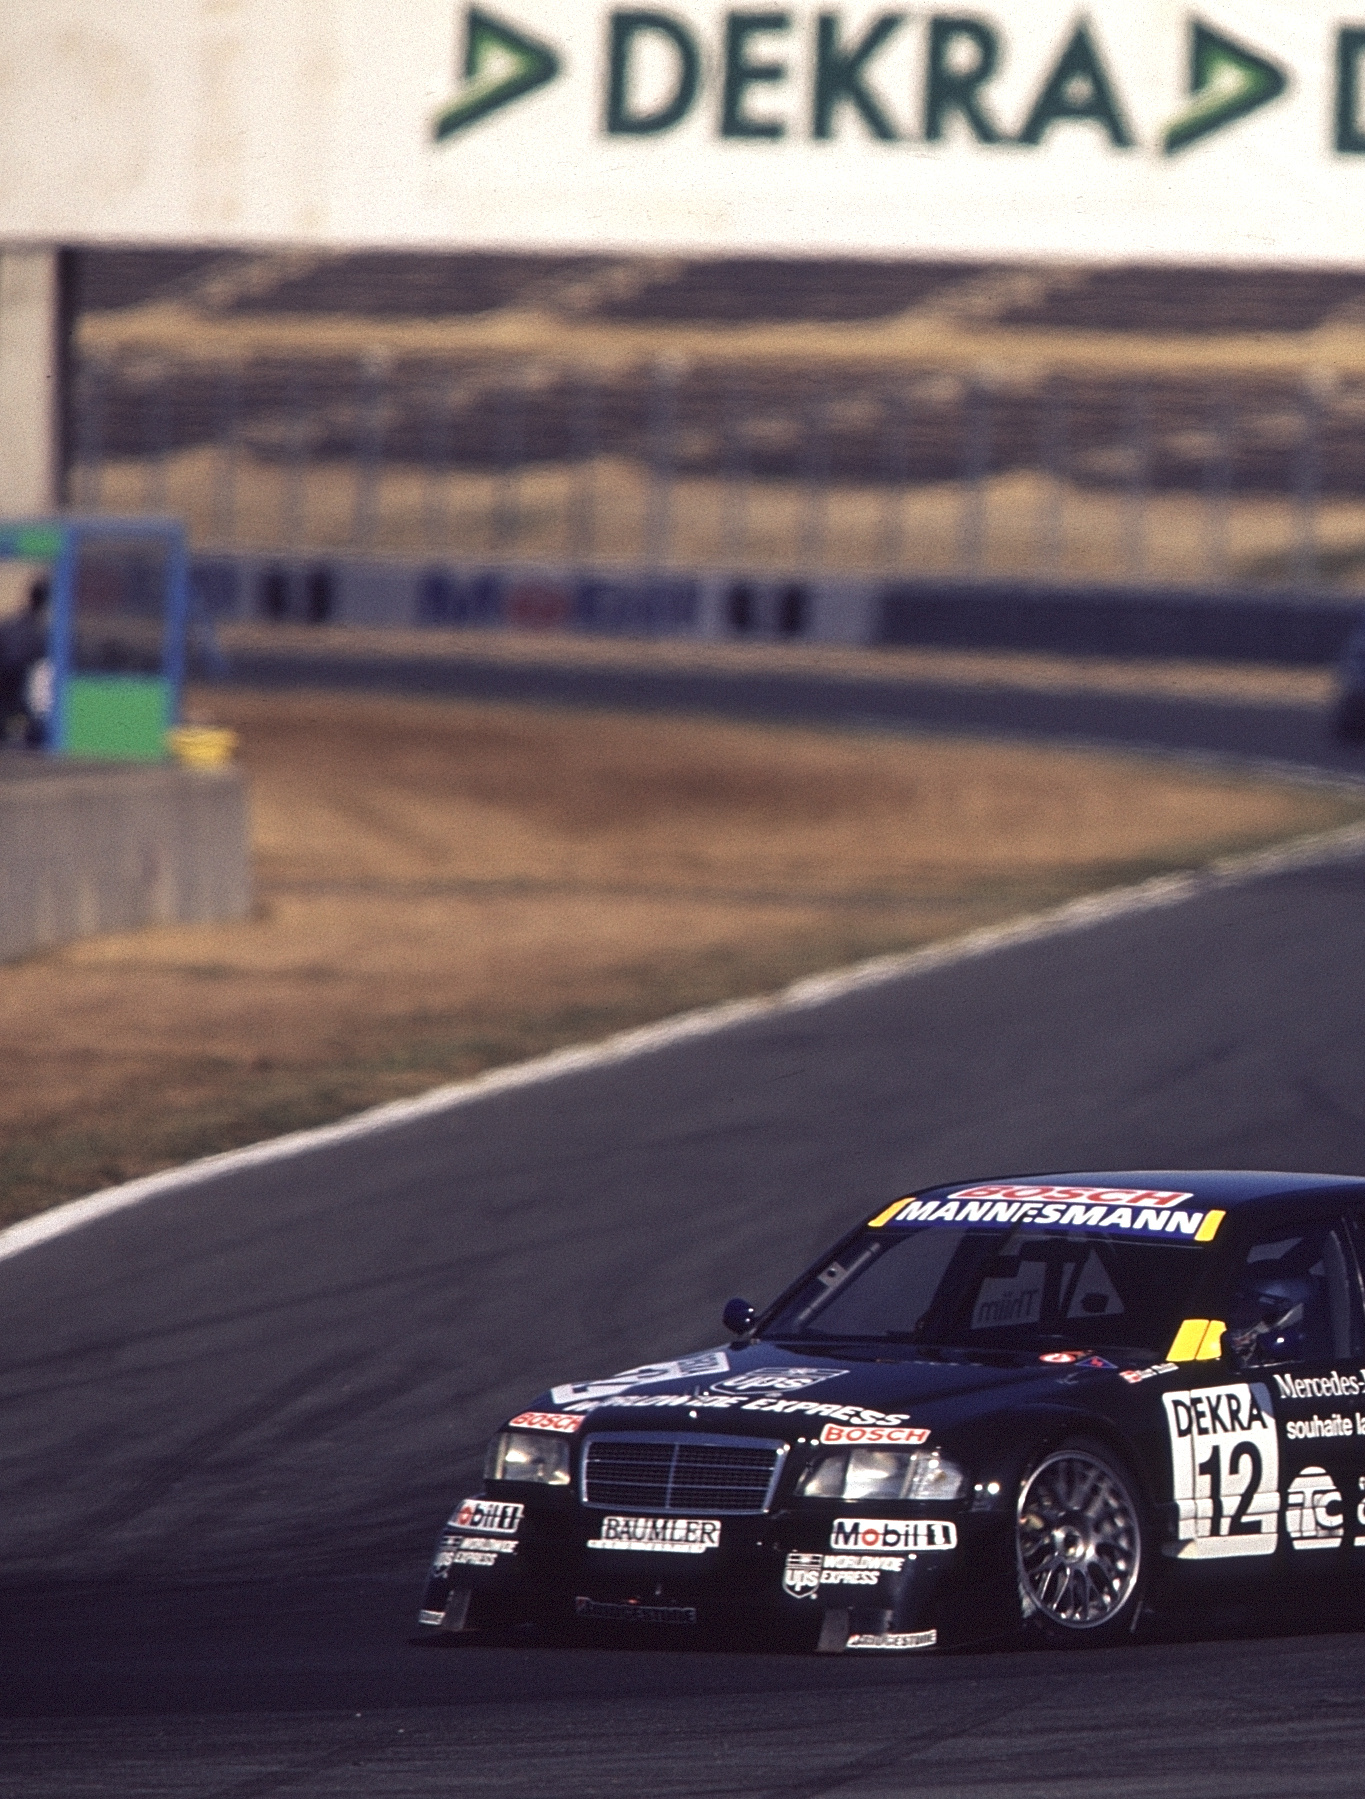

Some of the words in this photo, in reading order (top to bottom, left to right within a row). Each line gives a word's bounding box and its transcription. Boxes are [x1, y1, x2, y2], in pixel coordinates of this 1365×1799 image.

[599, 8, 1133, 149] DEKRA
[962, 1186, 1182, 1206] BOSCH
[896, 1201, 1206, 1234] MANNESMANN
[512, 1413, 582, 1431] BOSCH
[741, 1399, 911, 1425] EXPRESS
[1171, 1393, 1269, 1438] DEKRA
[824, 1426, 928, 1442] BOSCH
[1286, 1413, 1353, 1440] souhaite
[1198, 1441, 1263, 1536] 12
[456, 1503, 499, 1527] obil
[835, 1521, 919, 1547] Mobil
[785, 1569, 819, 1591] ups
[820, 1571, 880, 1585] EXPRESS
